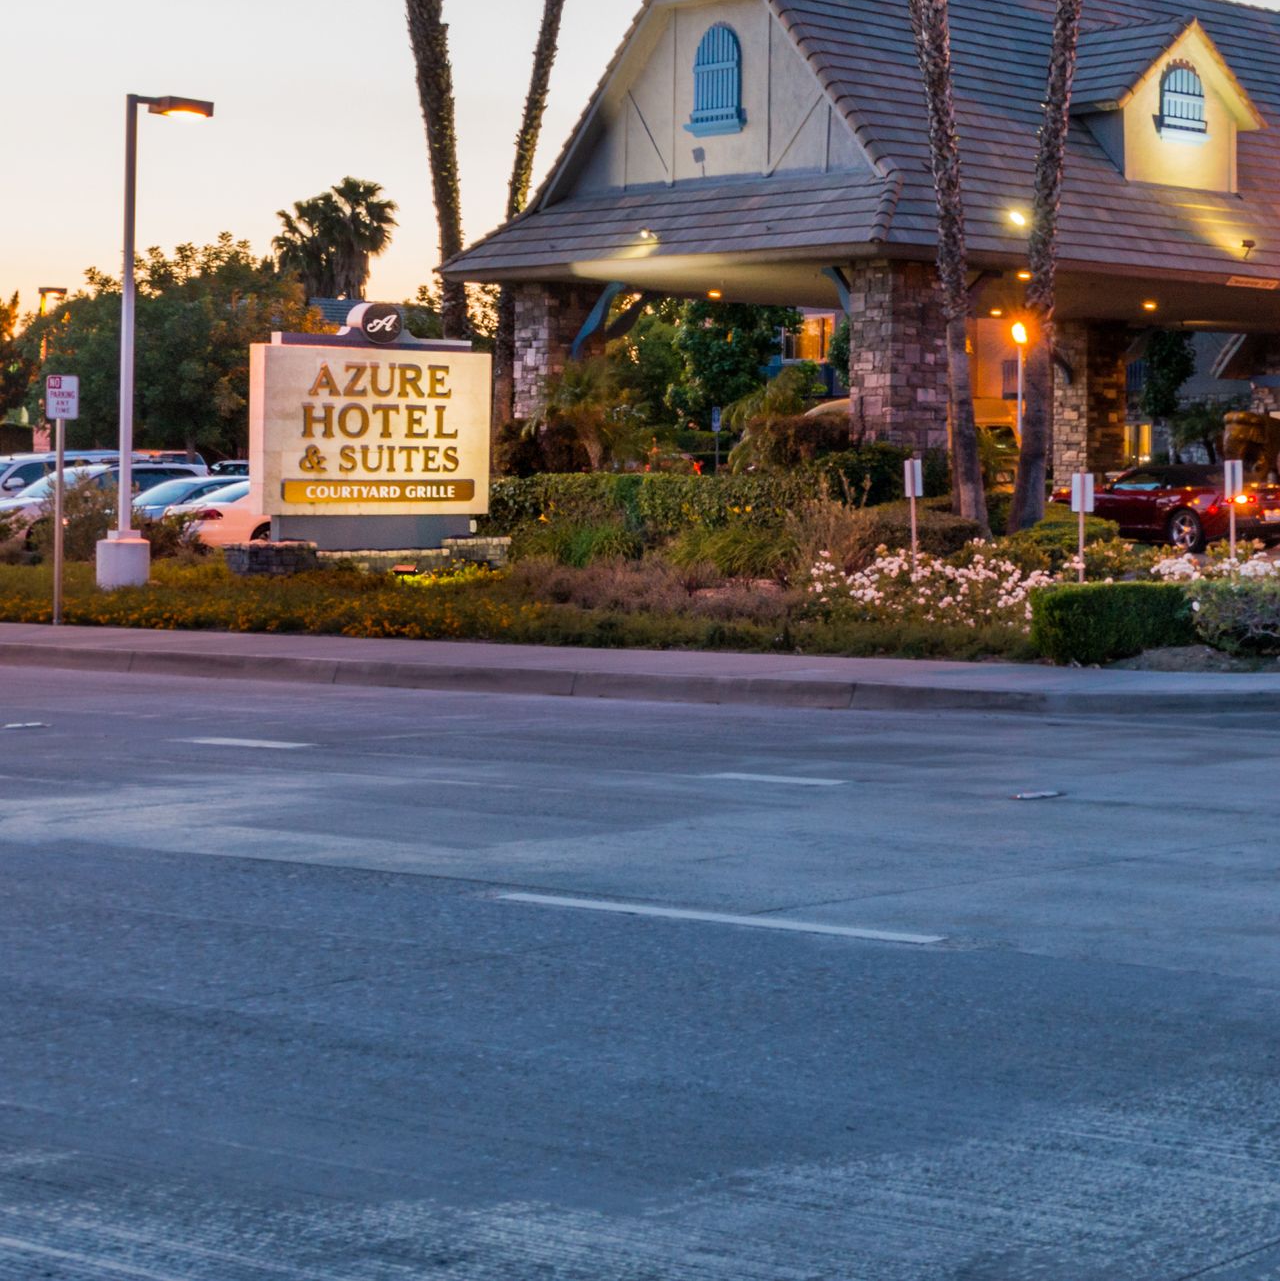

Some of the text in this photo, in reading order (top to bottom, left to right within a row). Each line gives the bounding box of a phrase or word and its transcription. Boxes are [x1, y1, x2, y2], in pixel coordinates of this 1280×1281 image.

[49, 378, 60, 388] NO
[308, 361, 452, 399] AZURE
[301, 402, 458, 439] HOTEL
[299, 444, 460, 473] & SUITES
[306, 485, 455, 498] COURTYARD GRILLE
